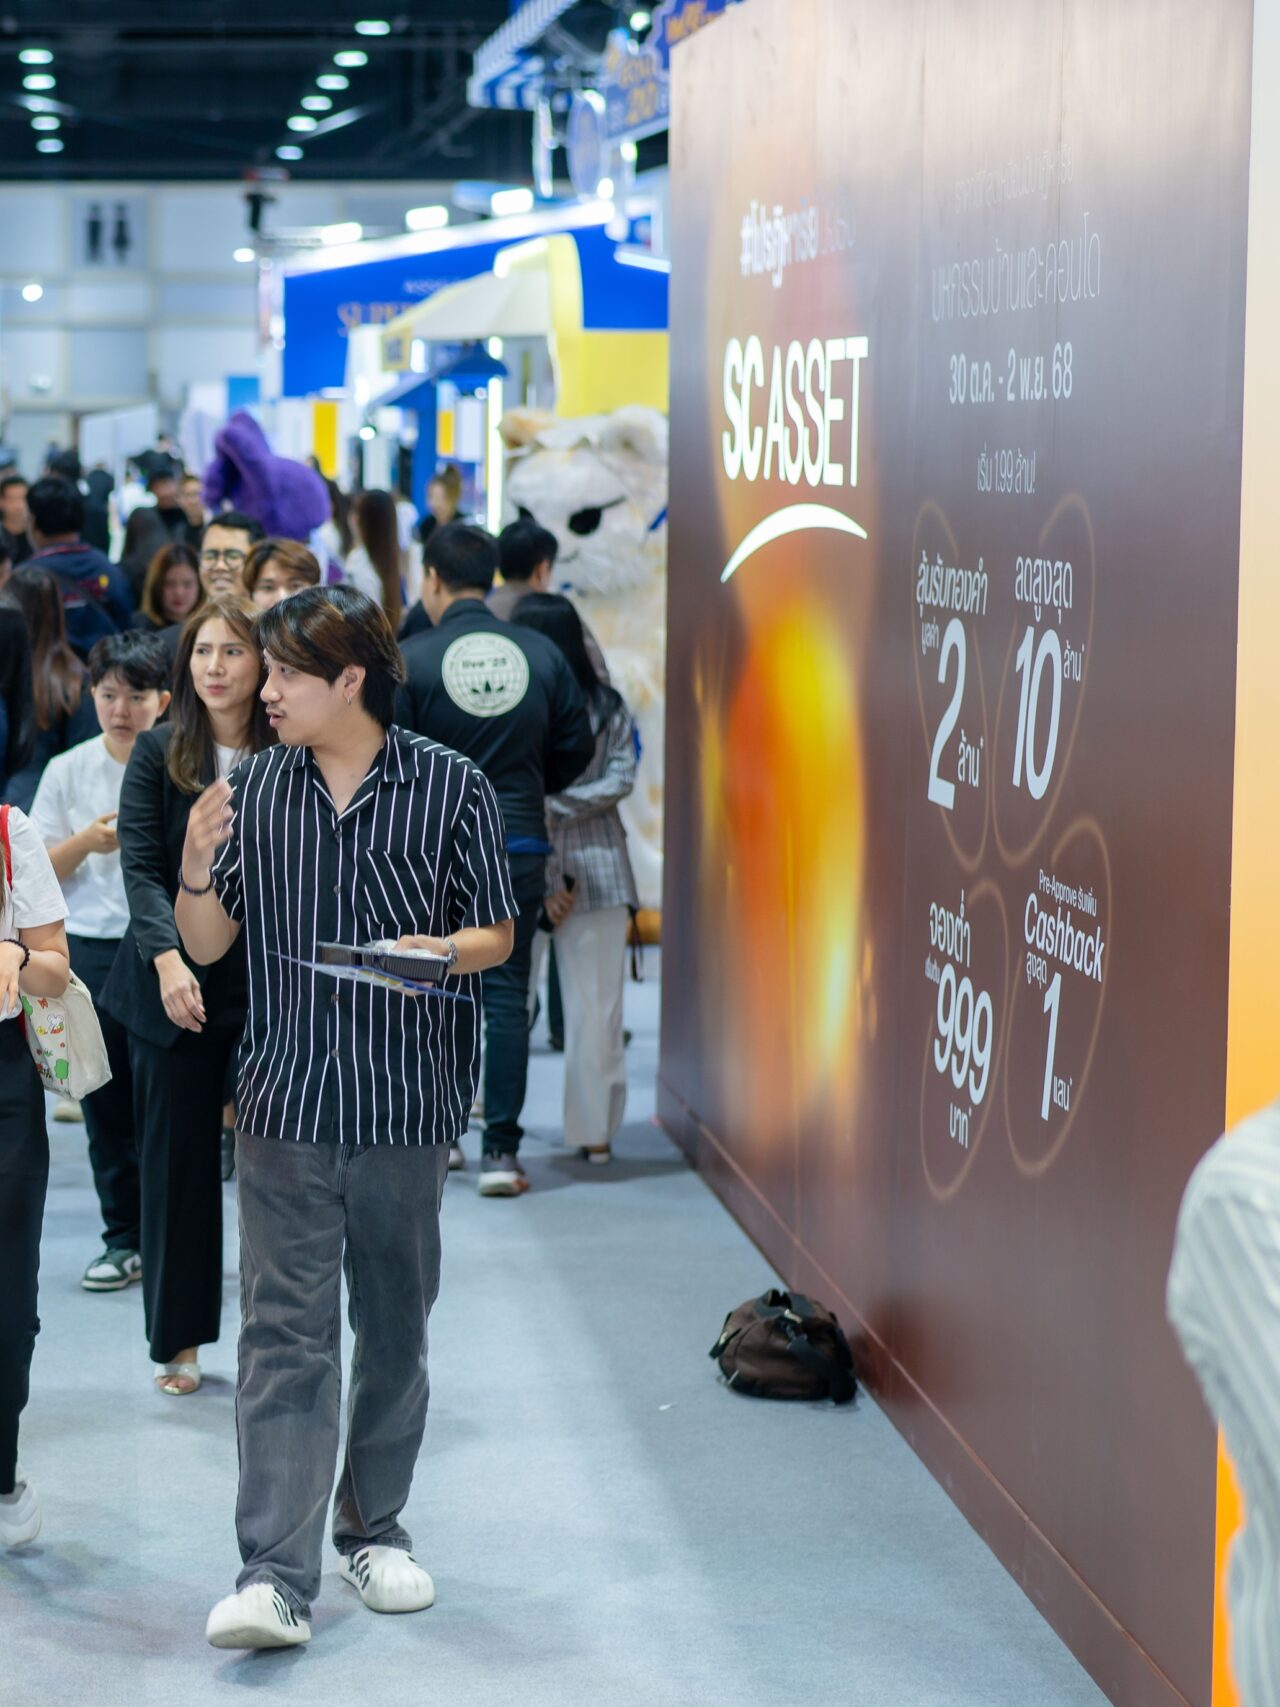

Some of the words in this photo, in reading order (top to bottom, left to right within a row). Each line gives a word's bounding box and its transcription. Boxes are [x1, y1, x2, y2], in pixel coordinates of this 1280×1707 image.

[949, 353, 967, 404] 30
[970, 360, 995, 403] ต.ค.
[1007, 347, 1016, 401] 2
[1020, 356, 1047, 401] พ.ย.
[1052, 341, 1073, 400] 68
[916, 549, 988, 617] ลุ้นรับทองคำ
[1015, 556, 1073, 624] ลดสูงสุด
[928, 617, 966, 811] 2
[1012, 625, 1062, 801] 10
[930, 888, 970, 968] จองต่ำ
[1024, 892, 1105, 983] Cashback
[934, 963, 993, 1105] 999
[1041, 972, 1062, 1121] 1
